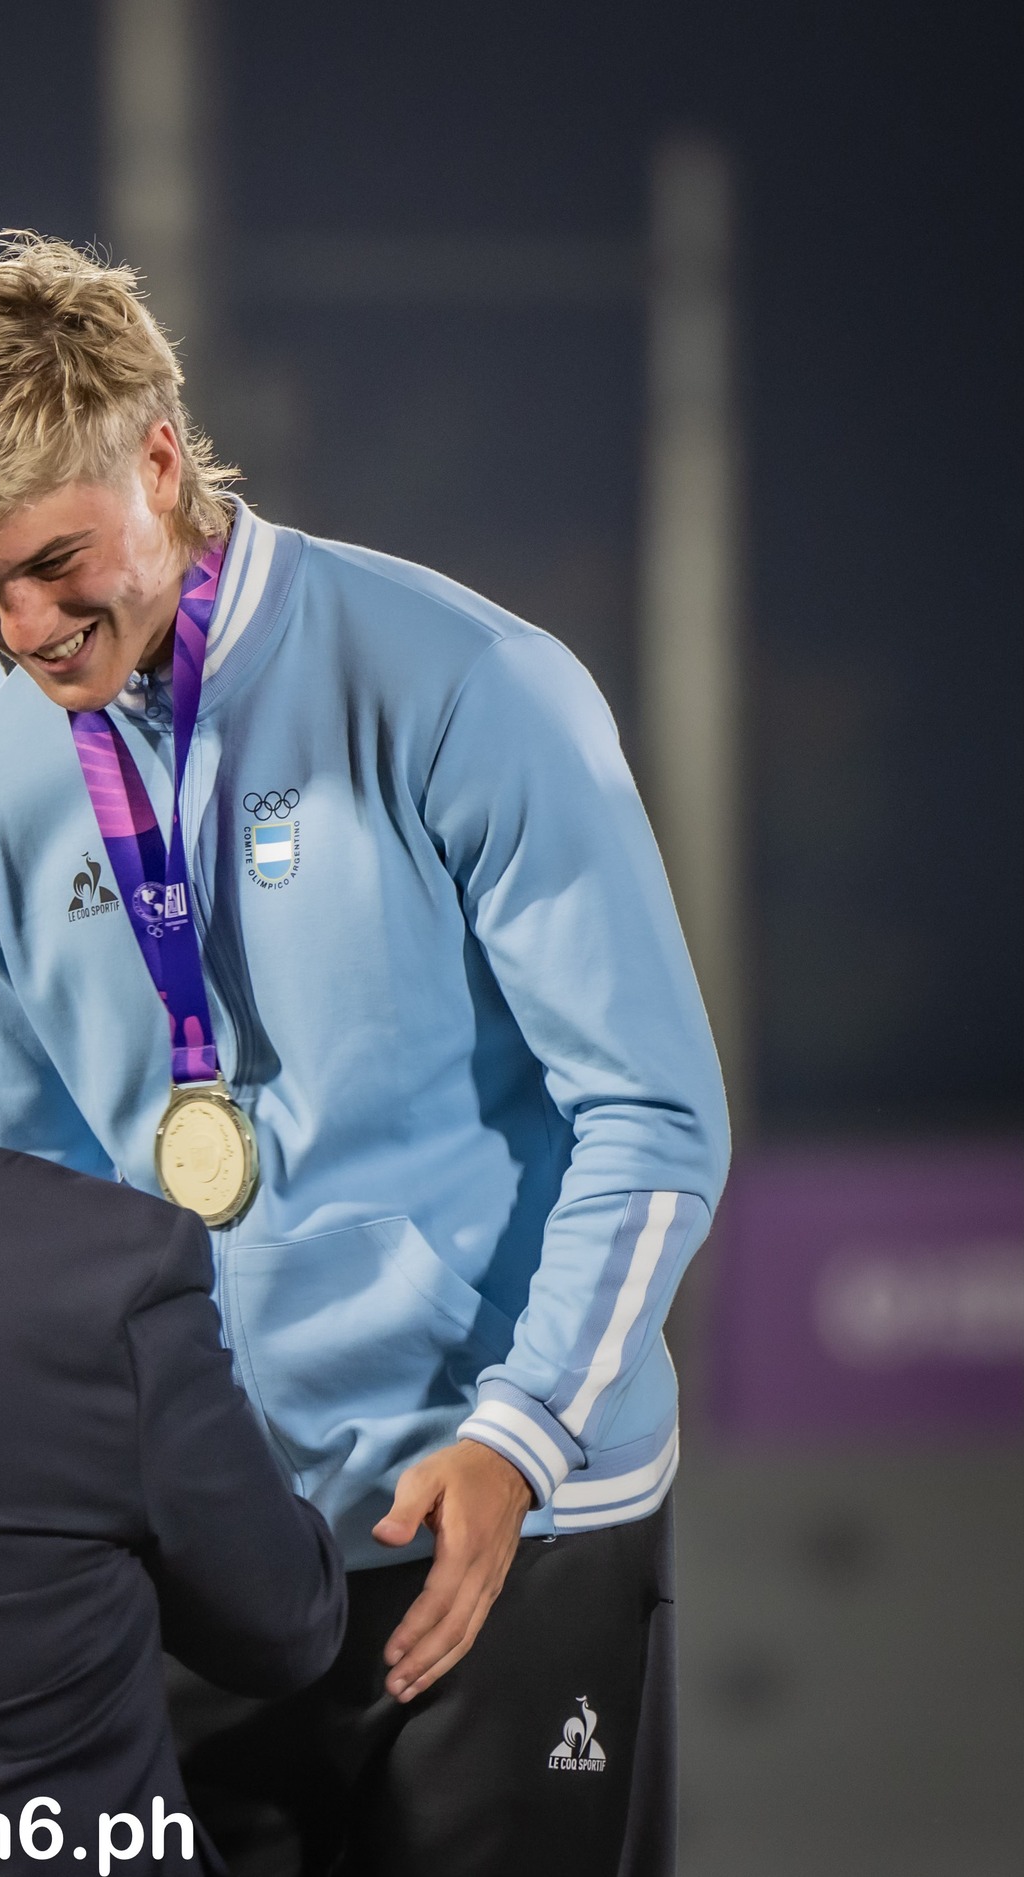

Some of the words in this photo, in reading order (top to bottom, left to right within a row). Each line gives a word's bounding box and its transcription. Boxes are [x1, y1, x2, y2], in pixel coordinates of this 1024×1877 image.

[243, 826, 254, 864] COMITE
[290, 820, 301, 878] ARGENTINO
[247, 869, 290, 890] OLIMPICO
[68, 911, 76, 923] LE
[76, 907, 90, 920] COQ
[90, 900, 120, 916] SPORTIF
[548, 1756, 559, 1770] LE
[560, 1757, 577, 1771] COQ
[578, 1758, 606, 1772] SPORTIF
